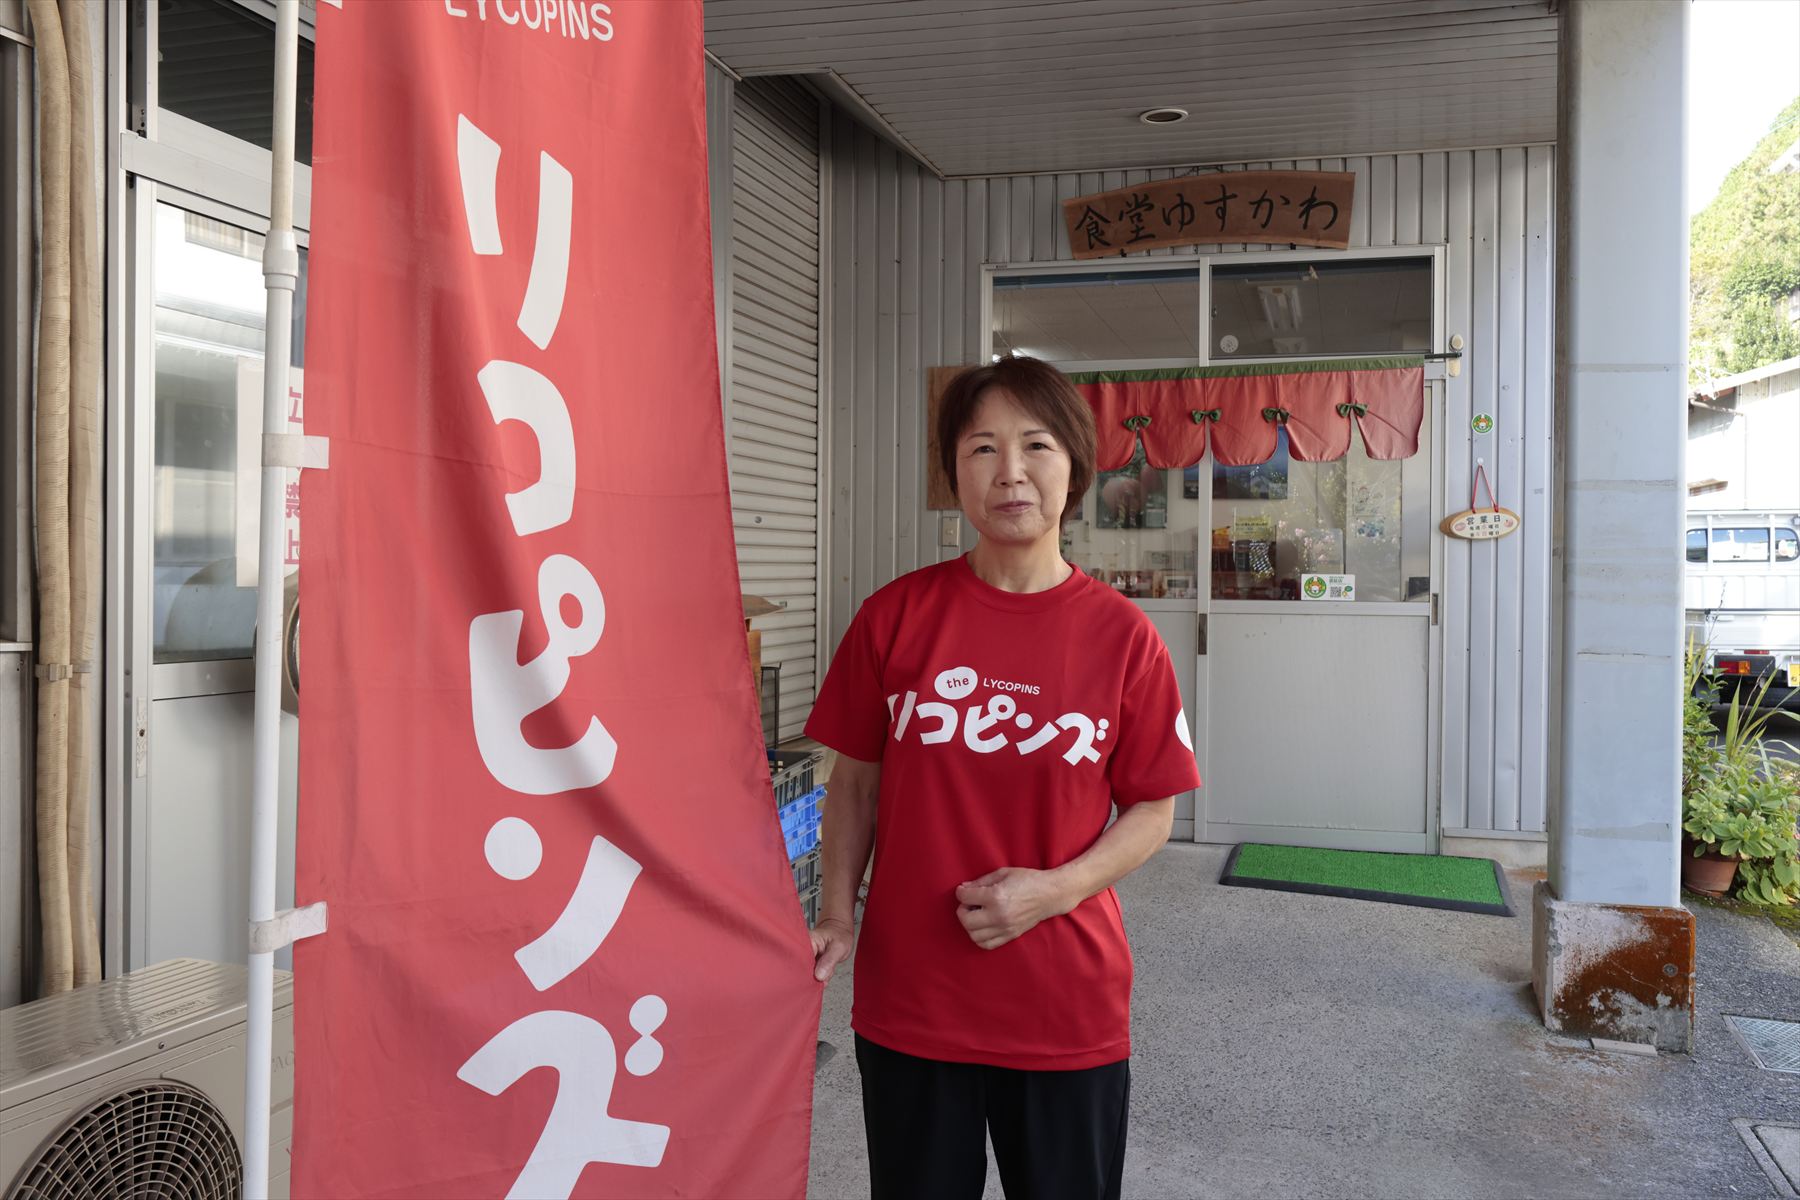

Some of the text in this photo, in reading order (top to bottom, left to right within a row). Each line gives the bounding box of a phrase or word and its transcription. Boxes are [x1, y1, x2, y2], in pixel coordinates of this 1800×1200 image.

[1075, 184, 1339, 250] 食堂ゆすかわ
[1466, 515, 1501, 525] 営業日
[946, 676, 970, 689] the
[983, 677, 1041, 695] LYCOPINS
[887, 690, 1110, 767] リコピンズ
